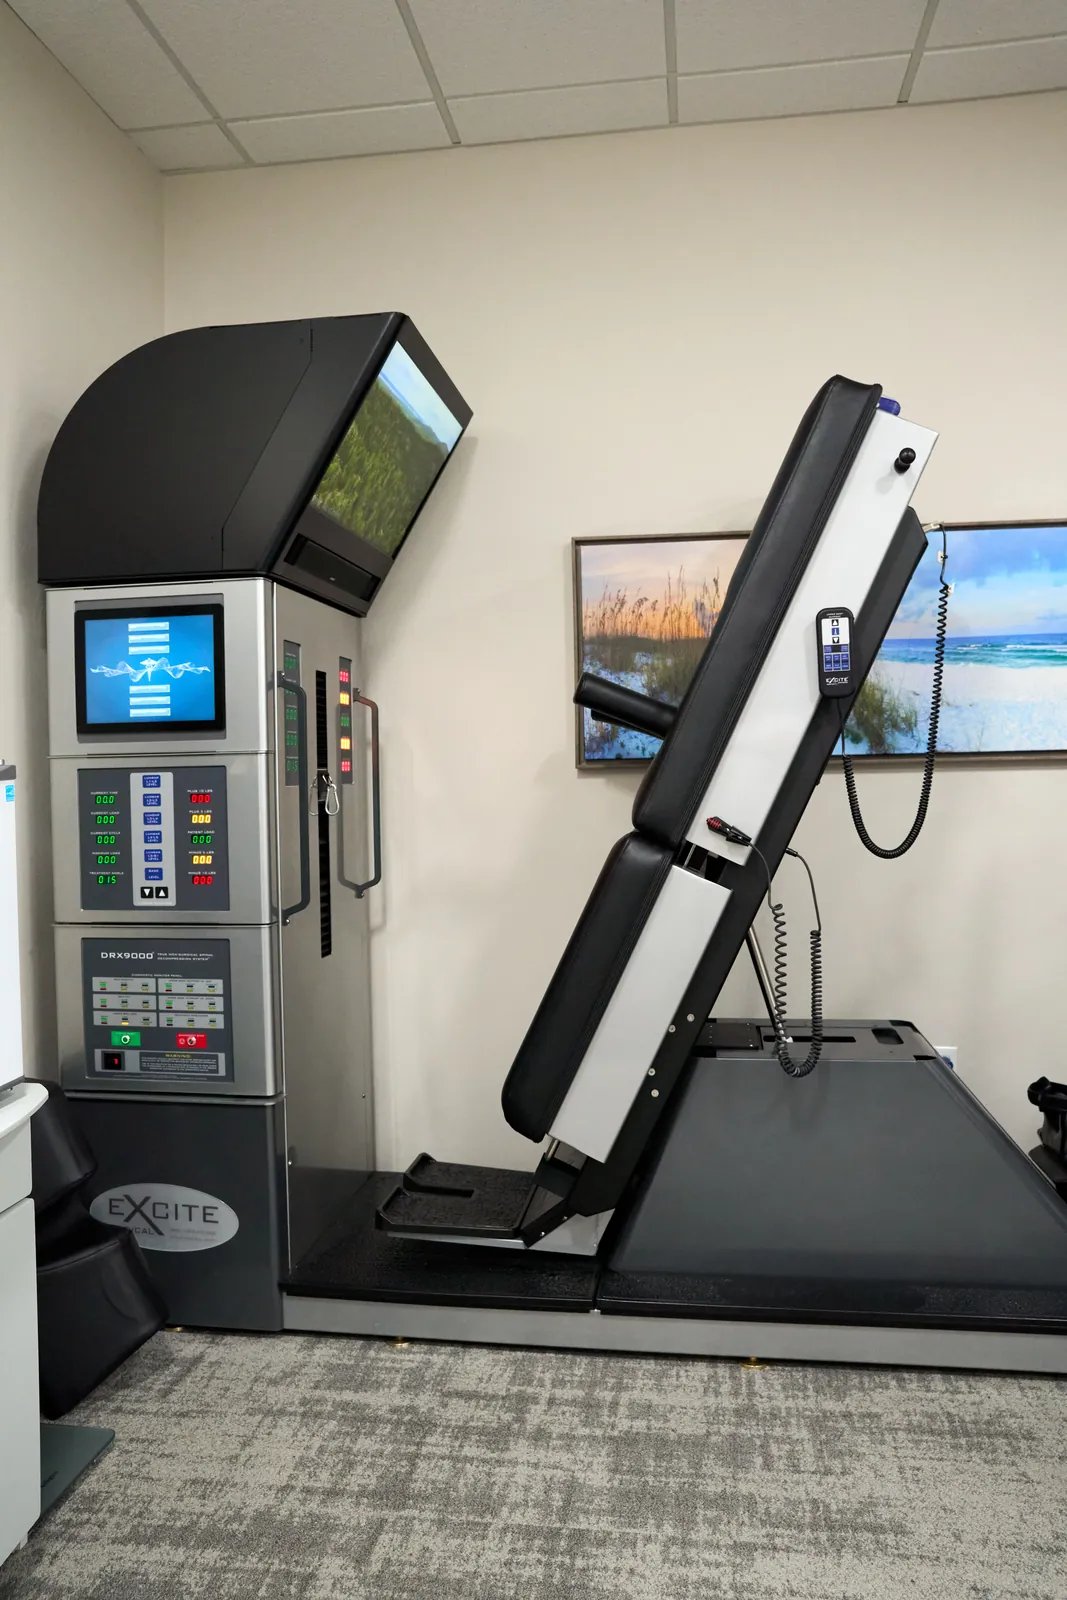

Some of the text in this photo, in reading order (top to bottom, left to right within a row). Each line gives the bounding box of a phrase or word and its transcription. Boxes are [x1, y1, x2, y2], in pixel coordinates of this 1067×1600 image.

[97, 816, 115, 824] 000
[192, 814, 211, 823] 000
[97, 836, 115, 844] 000
[192, 836, 212, 844] 000
[193, 855, 212, 864] 000
[98, 876, 116, 884] 015
[109, 1194, 219, 1236] EXCITE
